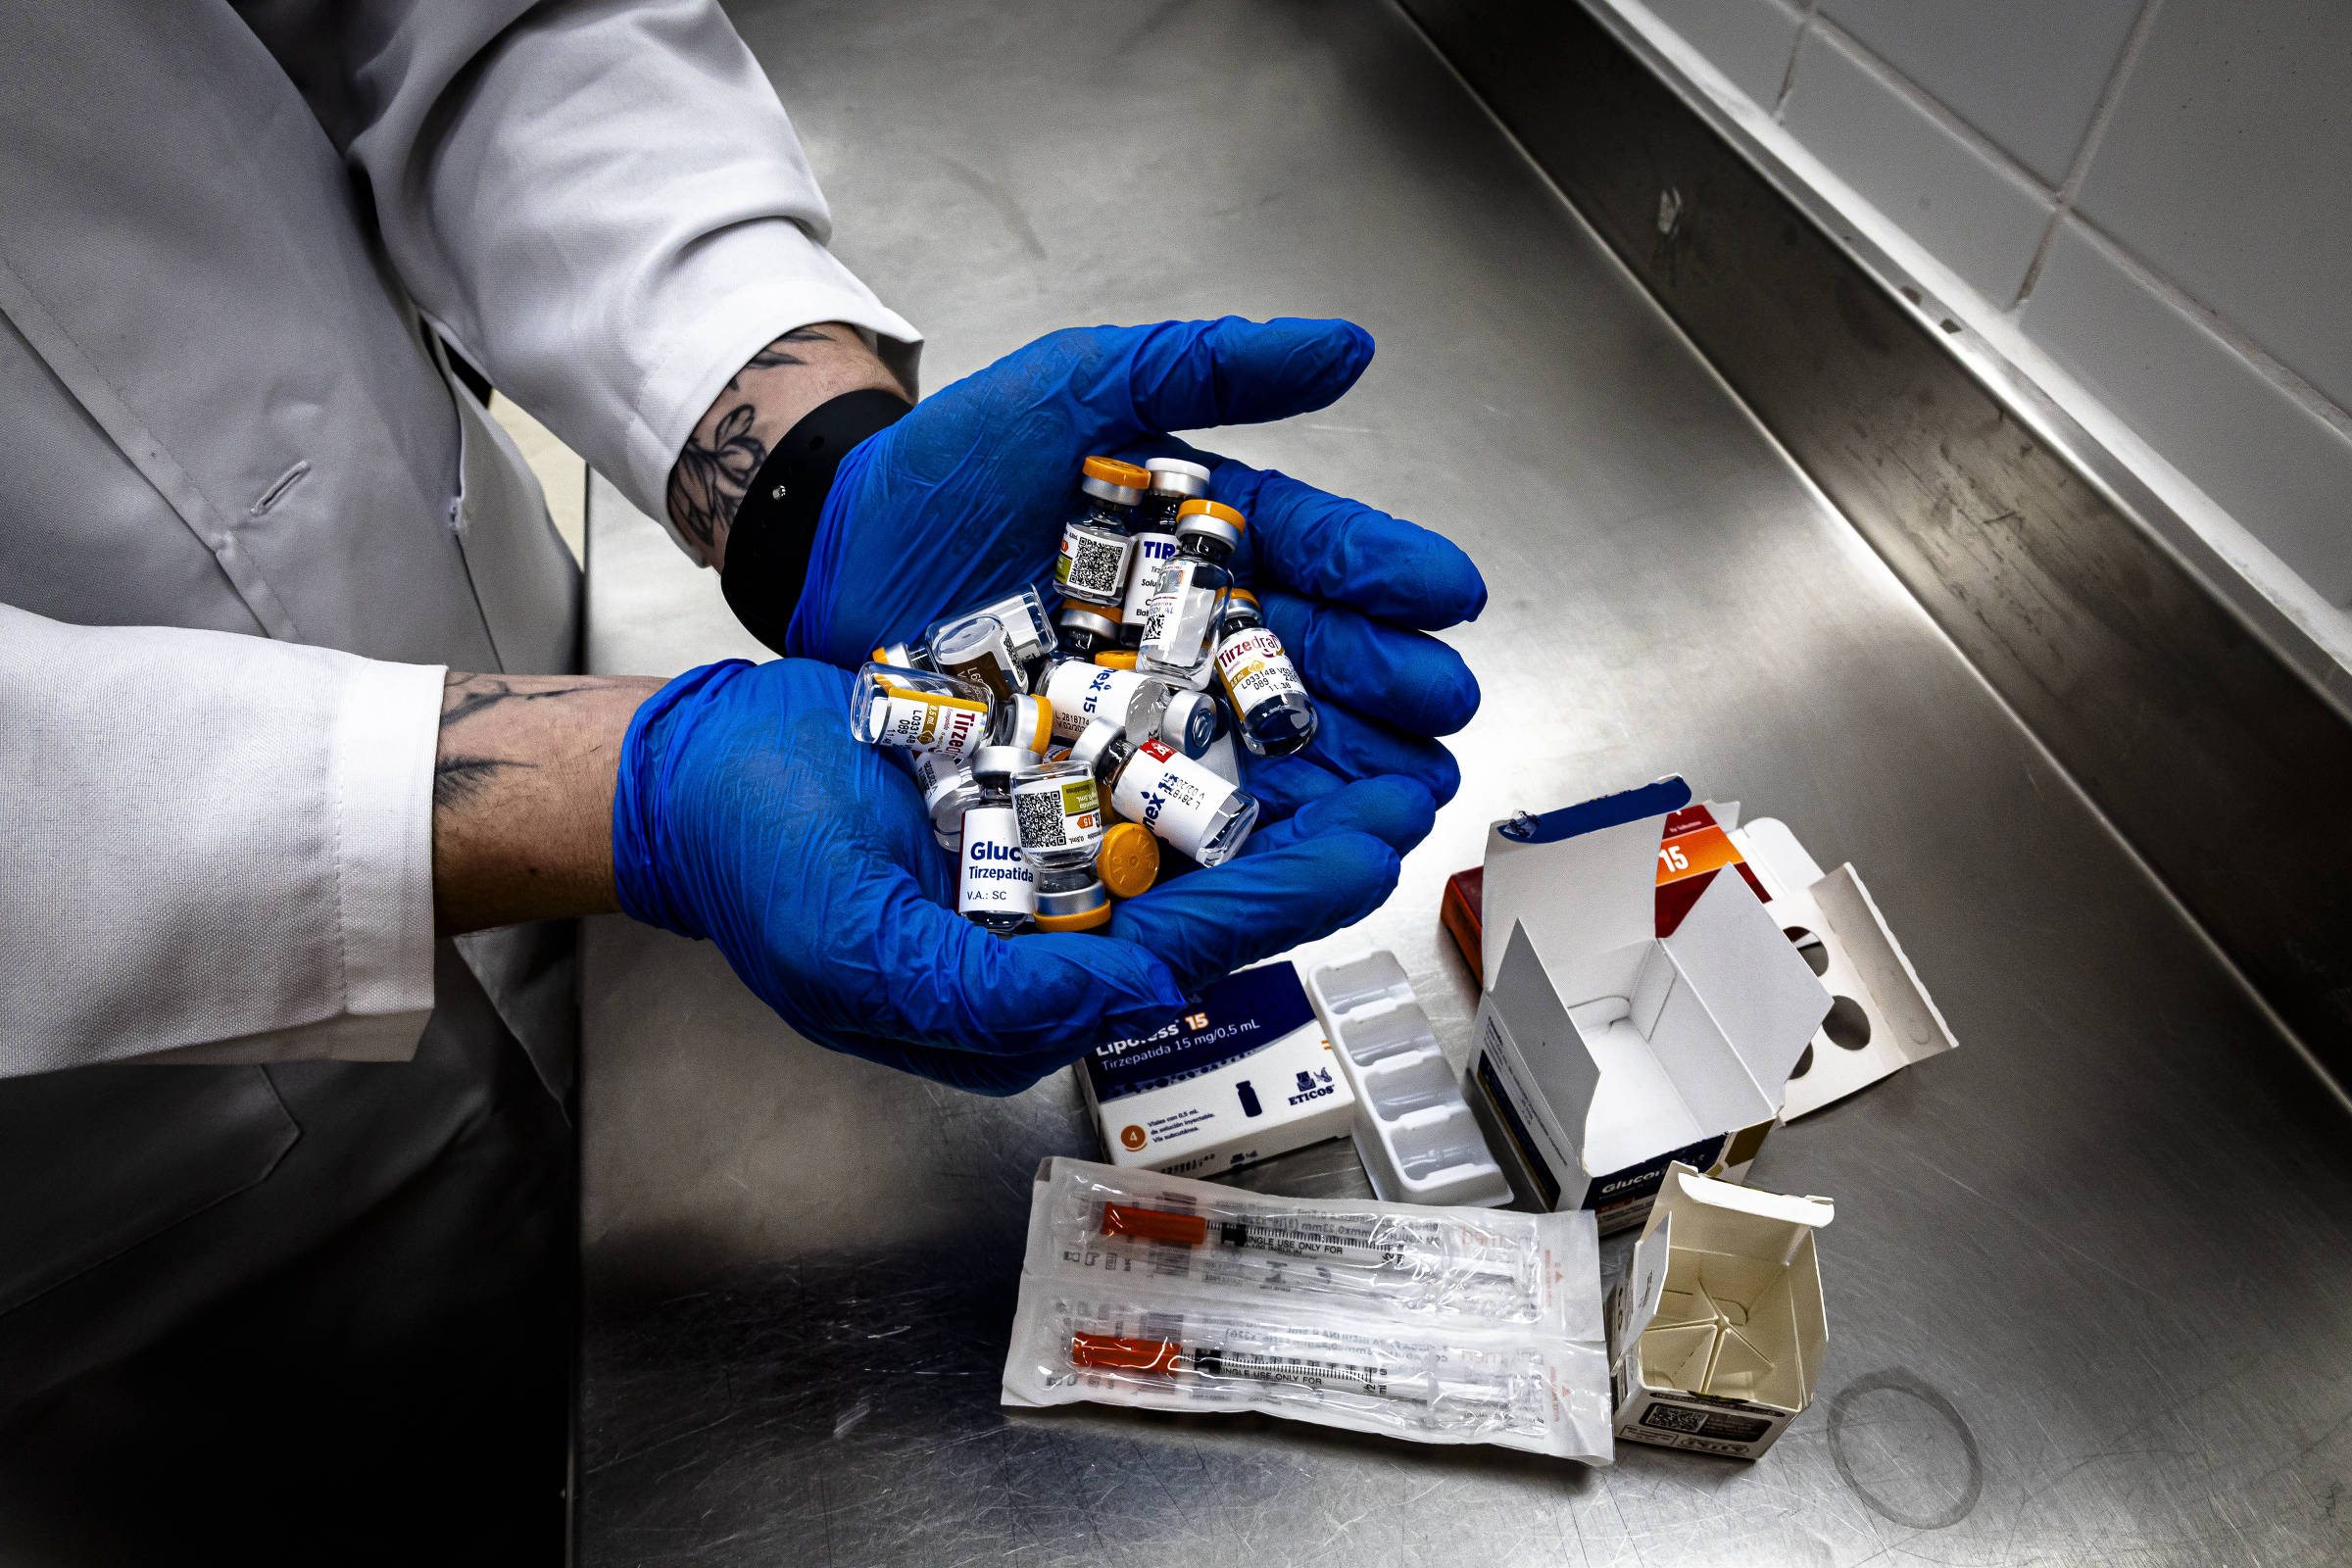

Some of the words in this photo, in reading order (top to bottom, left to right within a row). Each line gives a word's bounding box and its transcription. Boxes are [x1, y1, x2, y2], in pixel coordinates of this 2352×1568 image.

[1083, 695, 1098, 713] 15
[1659, 845, 1690, 873] 15
[968, 865, 1034, 883] Tirzepatida
[992, 891, 1007, 901] SC
[1096, 1023, 1180, 1056] Lipoess
[1184, 1011, 1209, 1031] 15
[1101, 1045, 1172, 1072] Tirzepatida
[1175, 1037, 1192, 1053] 15
[1240, 1018, 1261, 1033] mL
[1129, 1131, 1139, 1143] 4
[1244, 1235, 1274, 1248] INGLE
[1277, 1239, 1296, 1249] USE
[1298, 1243, 1321, 1253] ONLY
[1324, 1245, 1344, 1254] FOR
[1221, 1368, 1250, 1379] INGLE
[1253, 1372, 1273, 1381] USE
[1275, 1373, 1299, 1383] ONLY
[1302, 1376, 1323, 1386] FOR
